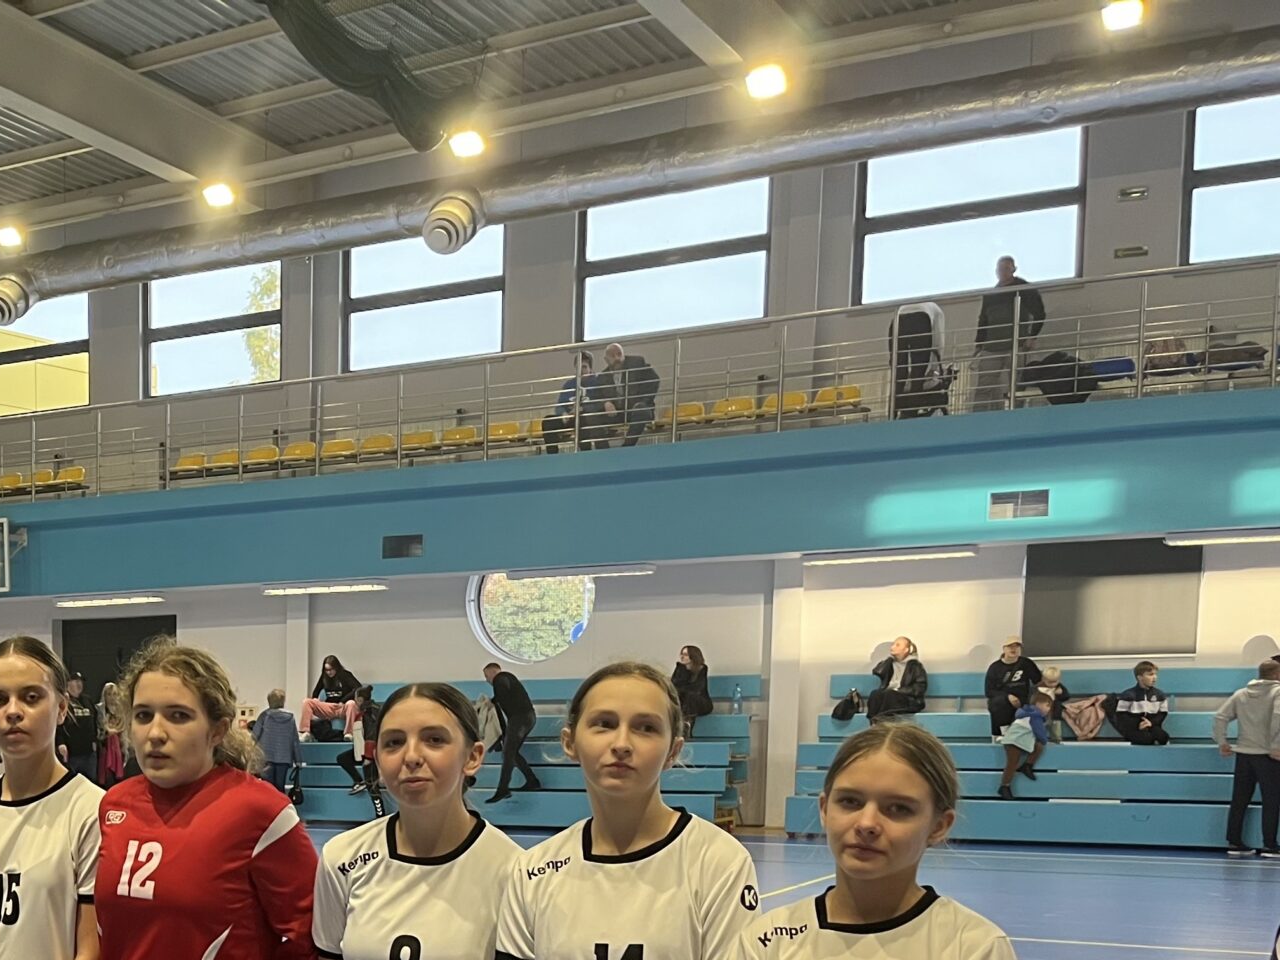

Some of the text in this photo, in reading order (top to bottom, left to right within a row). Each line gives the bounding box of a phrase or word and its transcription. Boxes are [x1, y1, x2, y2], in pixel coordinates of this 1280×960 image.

[117, 840, 163, 900] 12
[527, 856, 571, 880] Kempa
[758, 923, 808, 948] Kmpa
